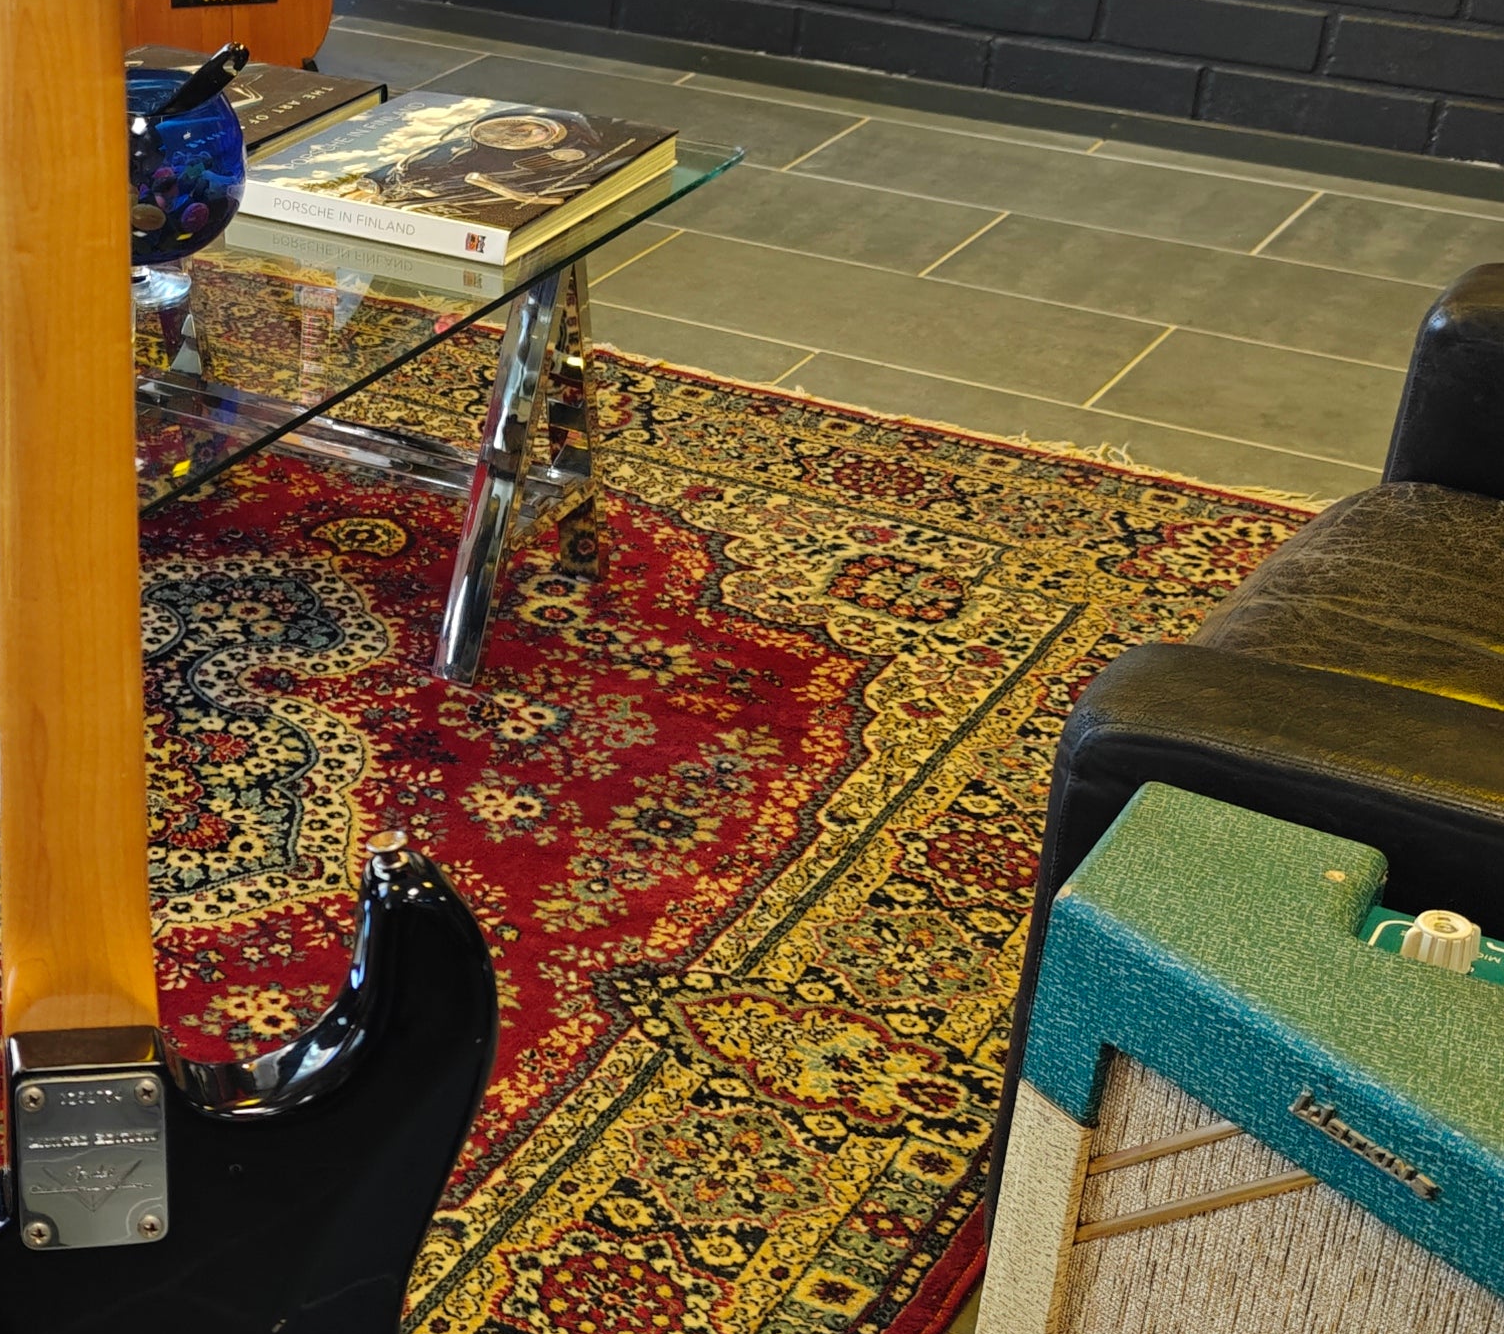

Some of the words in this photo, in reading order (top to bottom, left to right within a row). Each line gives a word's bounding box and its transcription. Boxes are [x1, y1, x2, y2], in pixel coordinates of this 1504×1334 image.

[302, 85, 335, 101] THE
[272, 99, 301, 115] ART
[248, 113, 269, 126] OF
[284, 136, 353, 169] PORSCHE
[347, 127, 371, 142] IN
[364, 101, 426, 132] FINLAND
[273, 197, 335, 221] PORSCHE
[338, 210, 353, 224] IN
[356, 213, 416, 237] FINLAND
